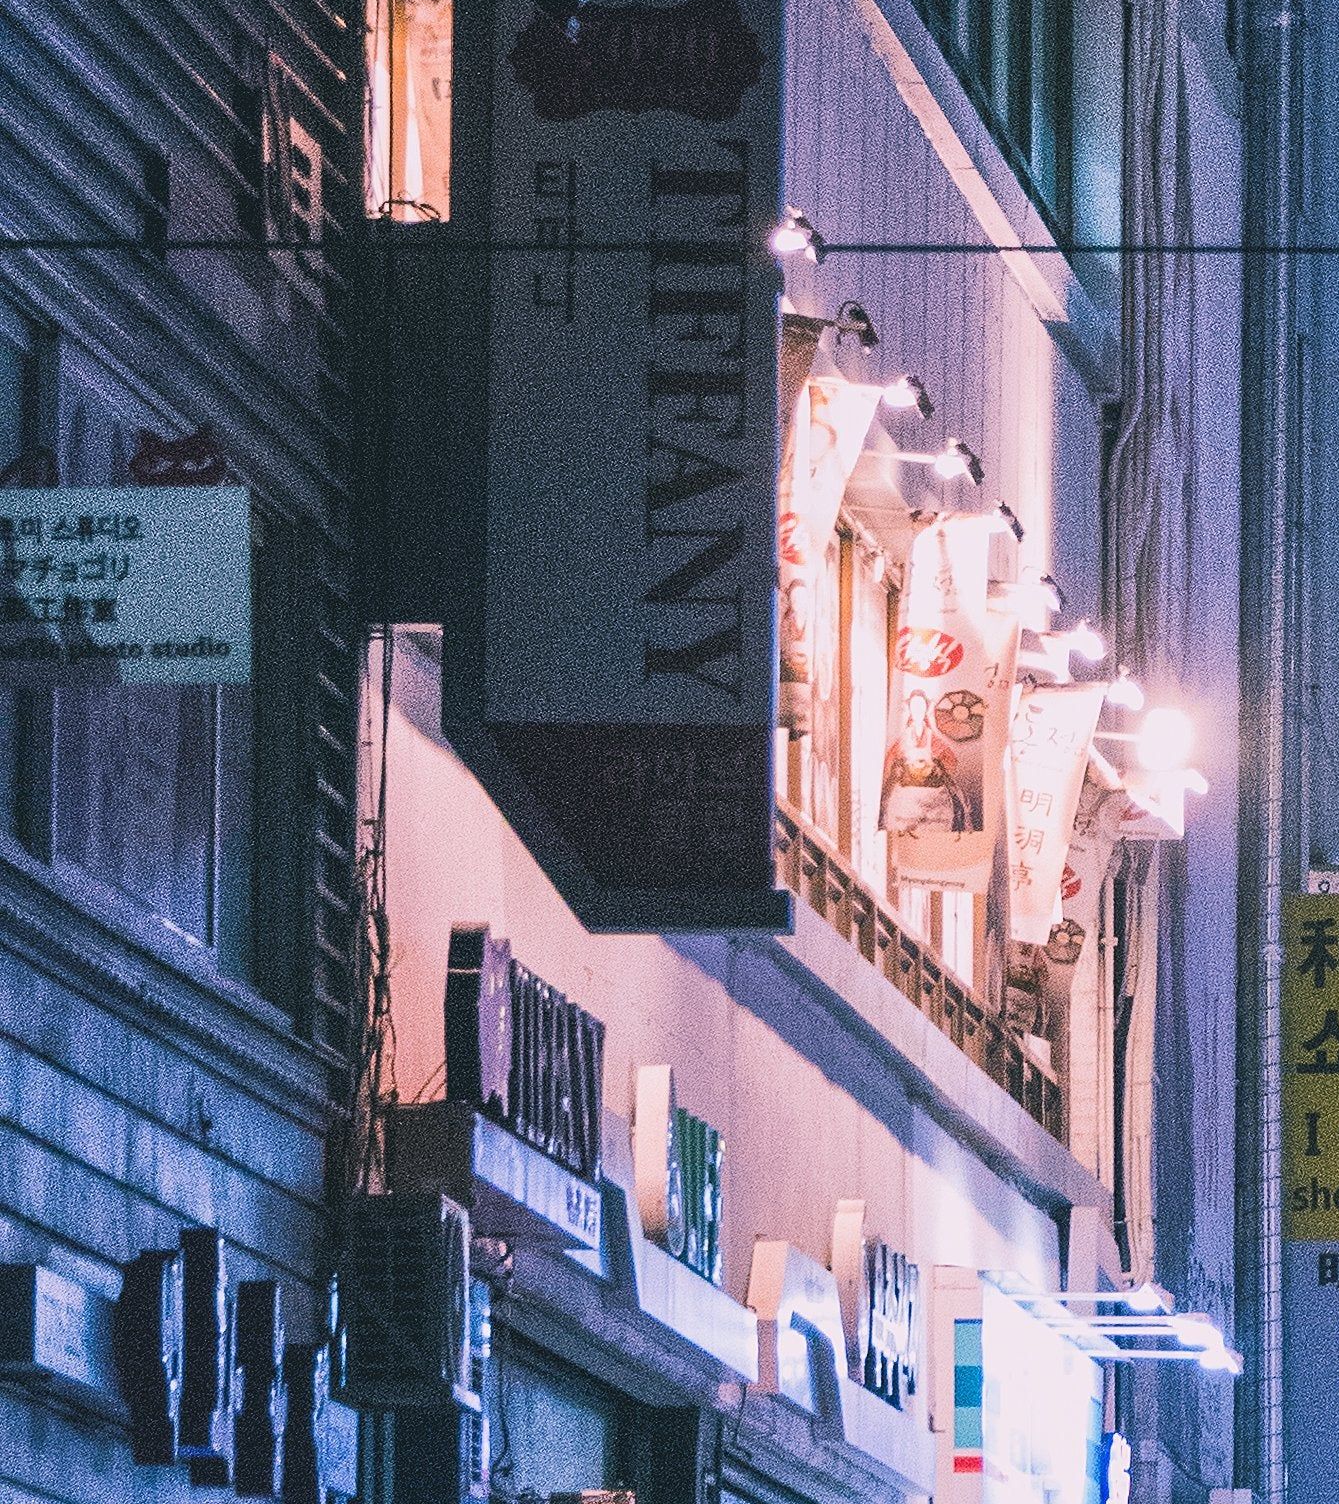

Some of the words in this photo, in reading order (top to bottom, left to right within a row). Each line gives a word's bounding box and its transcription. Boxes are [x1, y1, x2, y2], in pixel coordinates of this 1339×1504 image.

[643, 137, 746, 704] TIFFANY
[149, 634, 231, 659] studio
[1302, 1112, 1322, 1157] I
